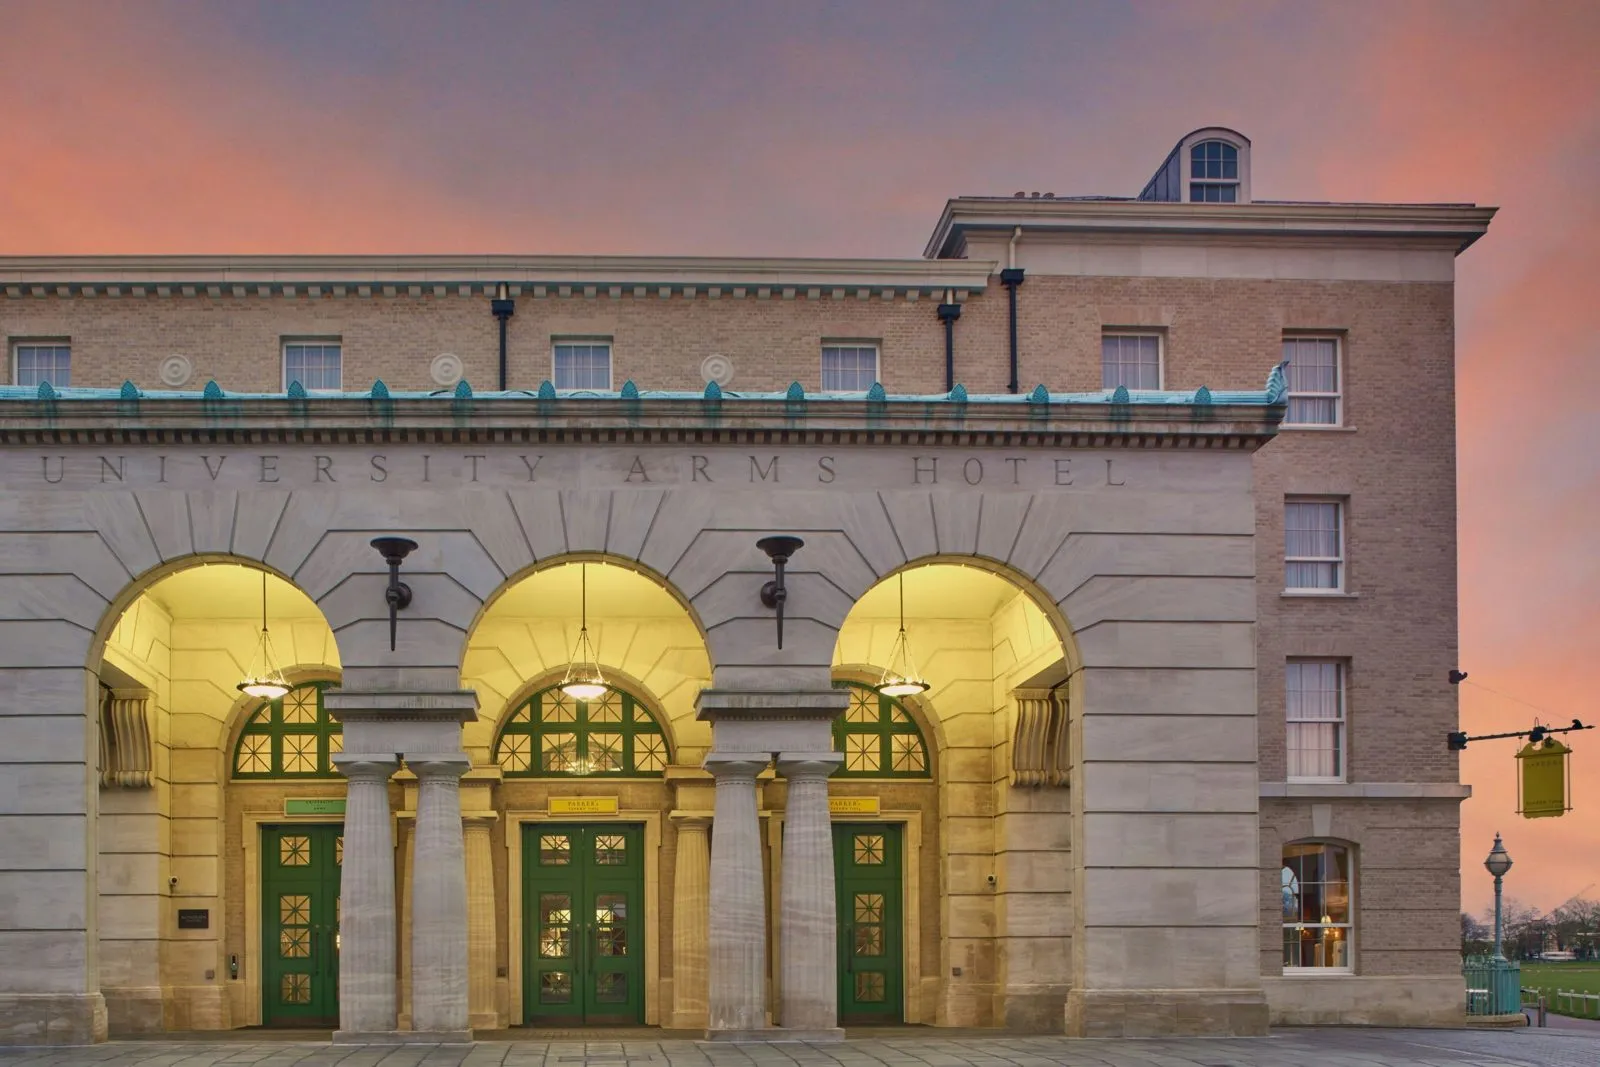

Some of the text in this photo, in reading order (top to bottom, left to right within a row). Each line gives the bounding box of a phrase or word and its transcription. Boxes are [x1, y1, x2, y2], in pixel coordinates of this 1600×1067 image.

[41, 455, 1125, 487] UNIVERSITY ARMS HOTEL
